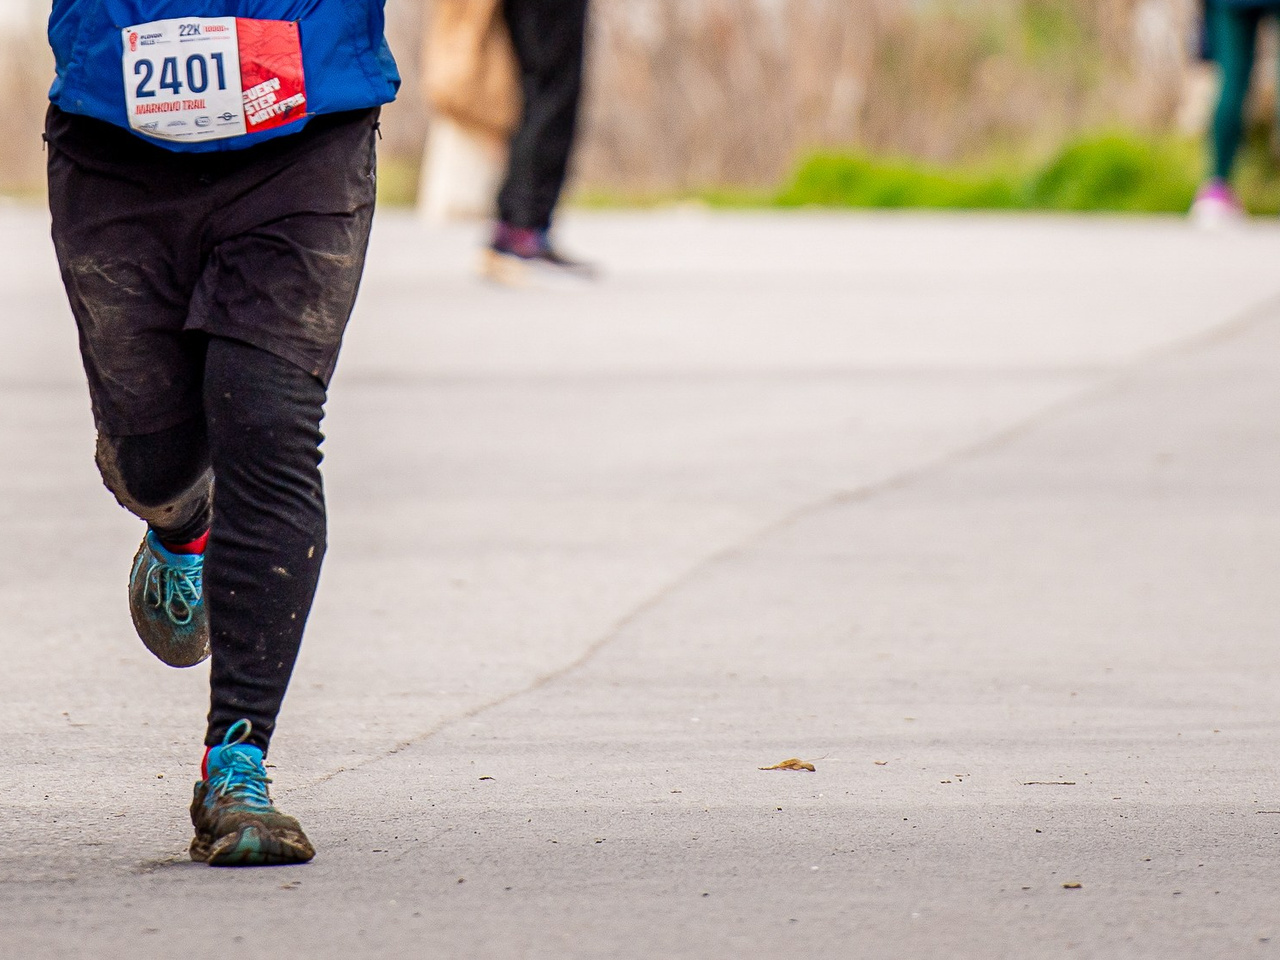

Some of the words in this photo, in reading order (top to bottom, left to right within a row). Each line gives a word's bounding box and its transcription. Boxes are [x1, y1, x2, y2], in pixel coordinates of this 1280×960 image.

[179, 23, 201, 37] 22K
[134, 52, 227, 98] 2401
[182, 99, 207, 110] TRAIL
[244, 92, 277, 115] STEP
